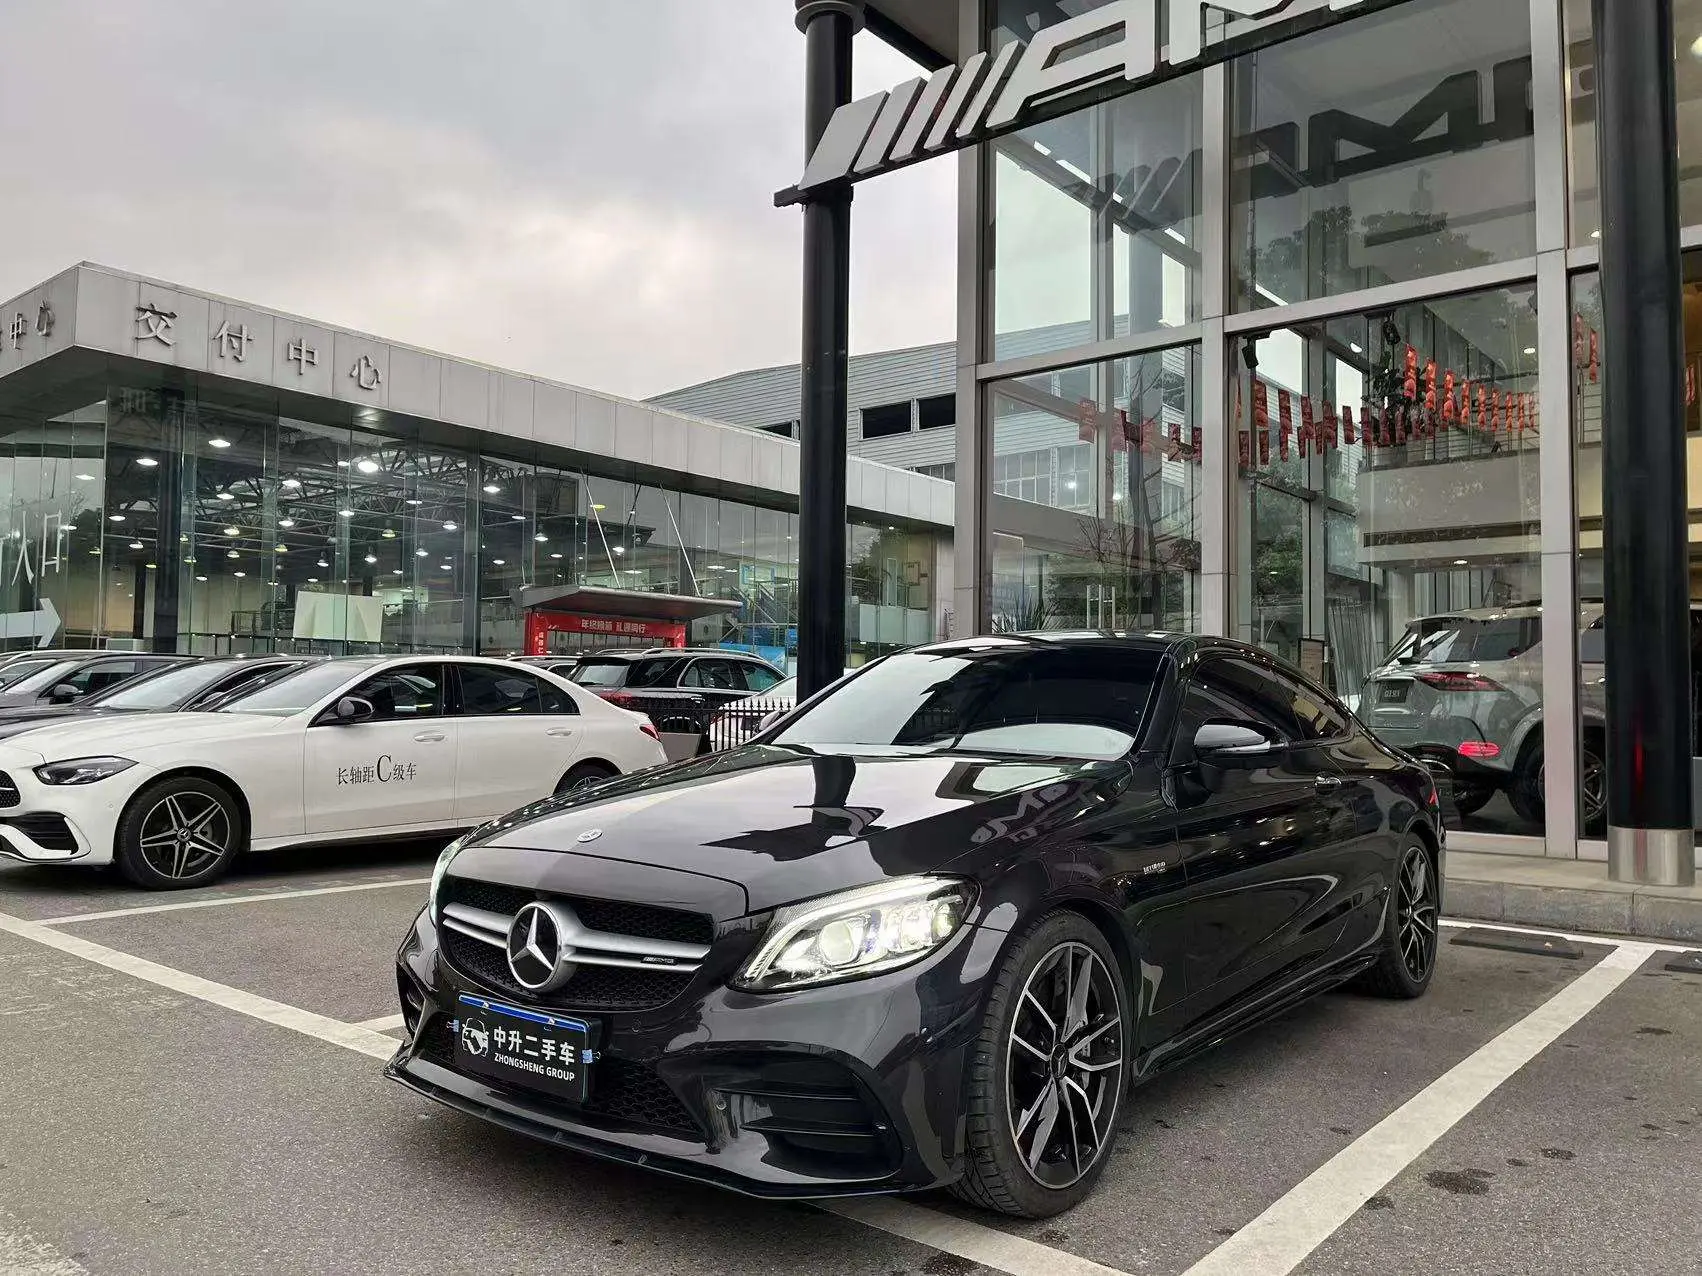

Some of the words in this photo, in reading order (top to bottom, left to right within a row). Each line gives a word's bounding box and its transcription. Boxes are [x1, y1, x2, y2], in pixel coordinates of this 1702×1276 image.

[0, 297, 55, 351] 中心
[135, 302, 382, 390] 交付中心
[0, 510, 63, 588] 入口
[337, 754, 417, 785] 长轴距C级车
[493, 1026, 575, 1065] 中升二手车
[494, 1053, 544, 1074] ZHONGSHENG
[547, 1067, 575, 1081] GROUP
